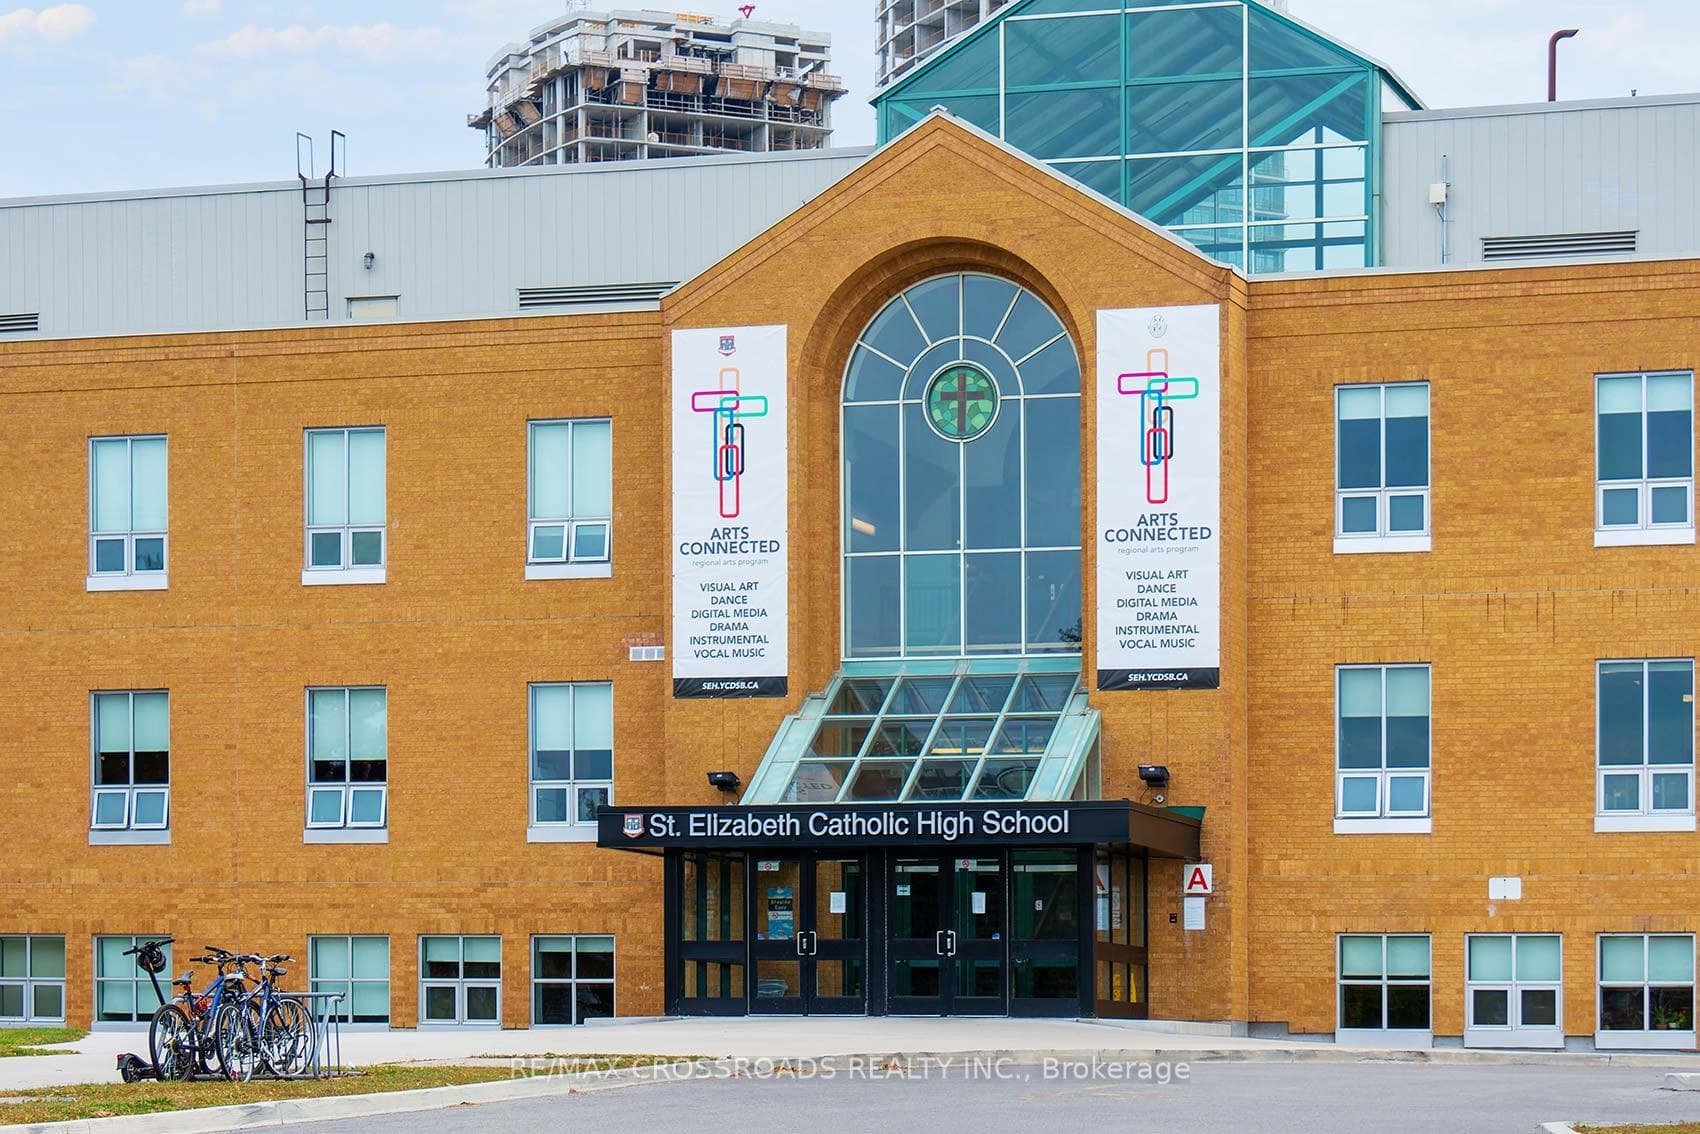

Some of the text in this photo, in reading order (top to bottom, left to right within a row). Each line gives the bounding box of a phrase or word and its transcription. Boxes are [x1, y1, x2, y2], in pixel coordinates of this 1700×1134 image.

[1137, 513, 1178, 527] ARTS
[710, 527, 749, 540] ARTS
[1104, 527, 1212, 542] CONNECTED
[680, 540, 780, 555] CONNECTED
[1118, 546, 1149, 555] regional
[1166, 546, 1200, 554] program
[692, 559, 721, 568] regional
[738, 559, 769, 567] program
[1126, 569, 1189, 580] VISUAL ART
[700, 582, 759, 592] VISUAL ART
[1137, 584, 1177, 594] DANCE
[711, 595, 748, 605] DANCE
[1117, 597, 1198, 608] DIGITAL MEDIA
[691, 608, 768, 619] DIGITAL MEDIA
[1136, 611, 1178, 621] DRAMA
[710, 622, 749, 632] DRAMA
[1115, 625, 1200, 635] INSTRUMENTAL
[690, 635, 769, 645] INSTRUMENTAL
[1119, 638, 1196, 649] VOCAL MUSIC
[694, 648, 766, 658] VOCAL MUSIC
[1127, 672, 1189, 682] SEH.YCDSB.CA
[702, 681, 759, 690] SEH.YCDSB.CA
[650, 810, 1069, 841] St. Elizabeth Catholic High School
[1187, 867, 1208, 890] A
